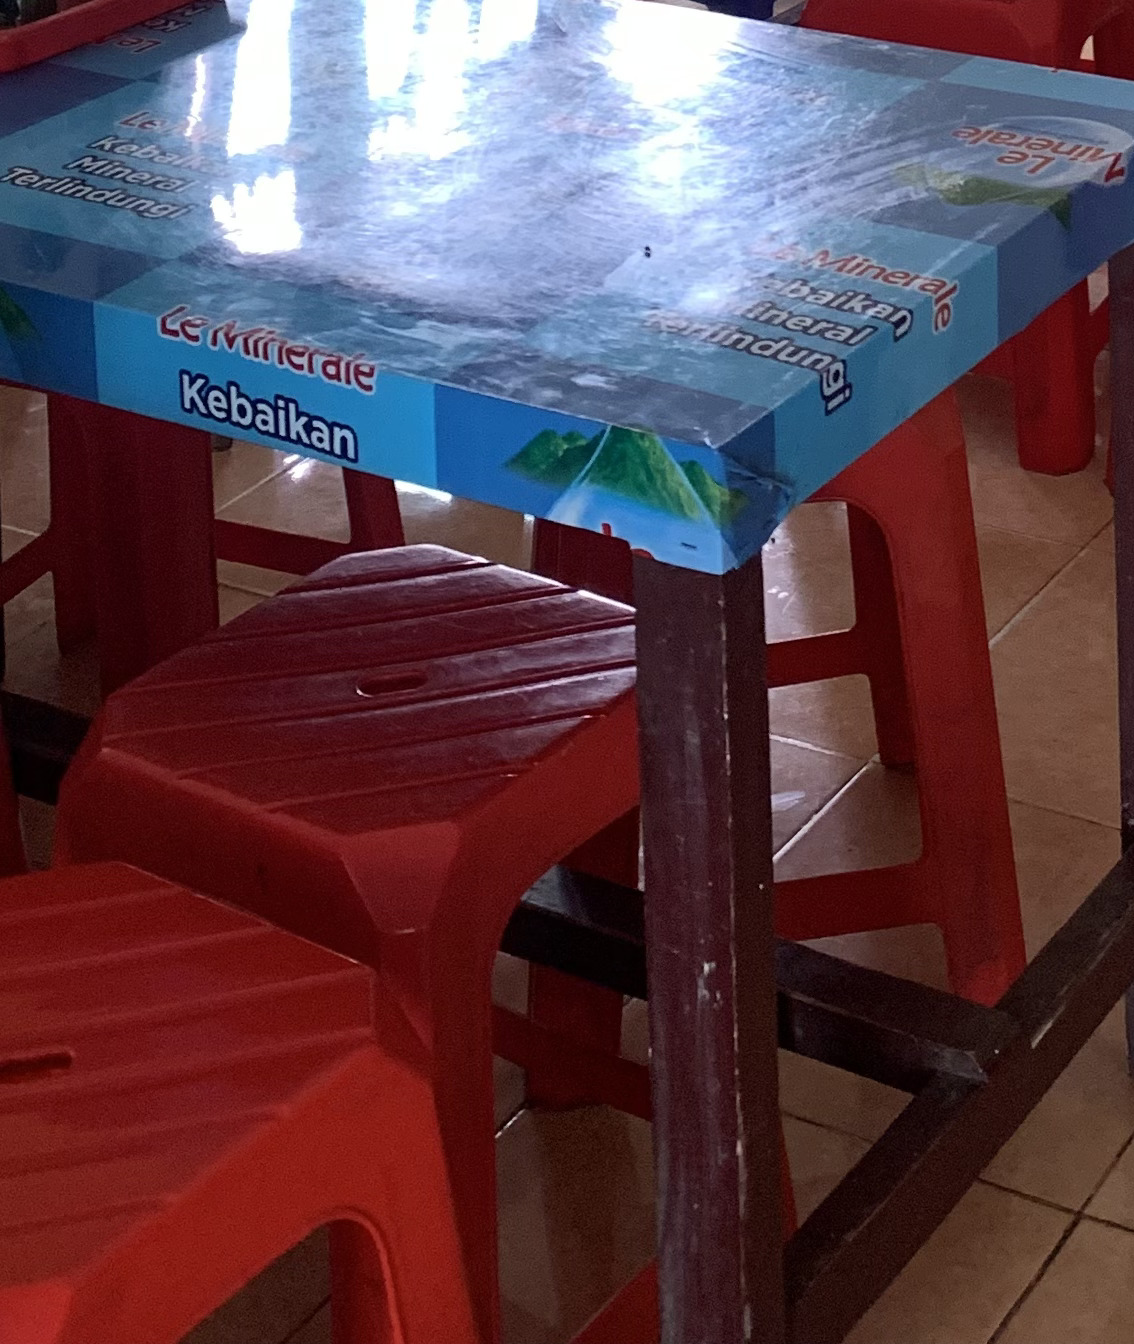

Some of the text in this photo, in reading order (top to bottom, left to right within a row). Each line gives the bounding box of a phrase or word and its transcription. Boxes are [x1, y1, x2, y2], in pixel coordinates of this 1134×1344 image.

[63, 155, 197, 193] Mineral
[951, 126, 1127, 185] Minerale
[996, 150, 1056, 176] Le
[1, 166, 198, 219] Terlindungi
[804, 249, 958, 335] Minerale
[159, 304, 376, 394] Le Minerale
[179, 368, 359, 463] Kebaikan
